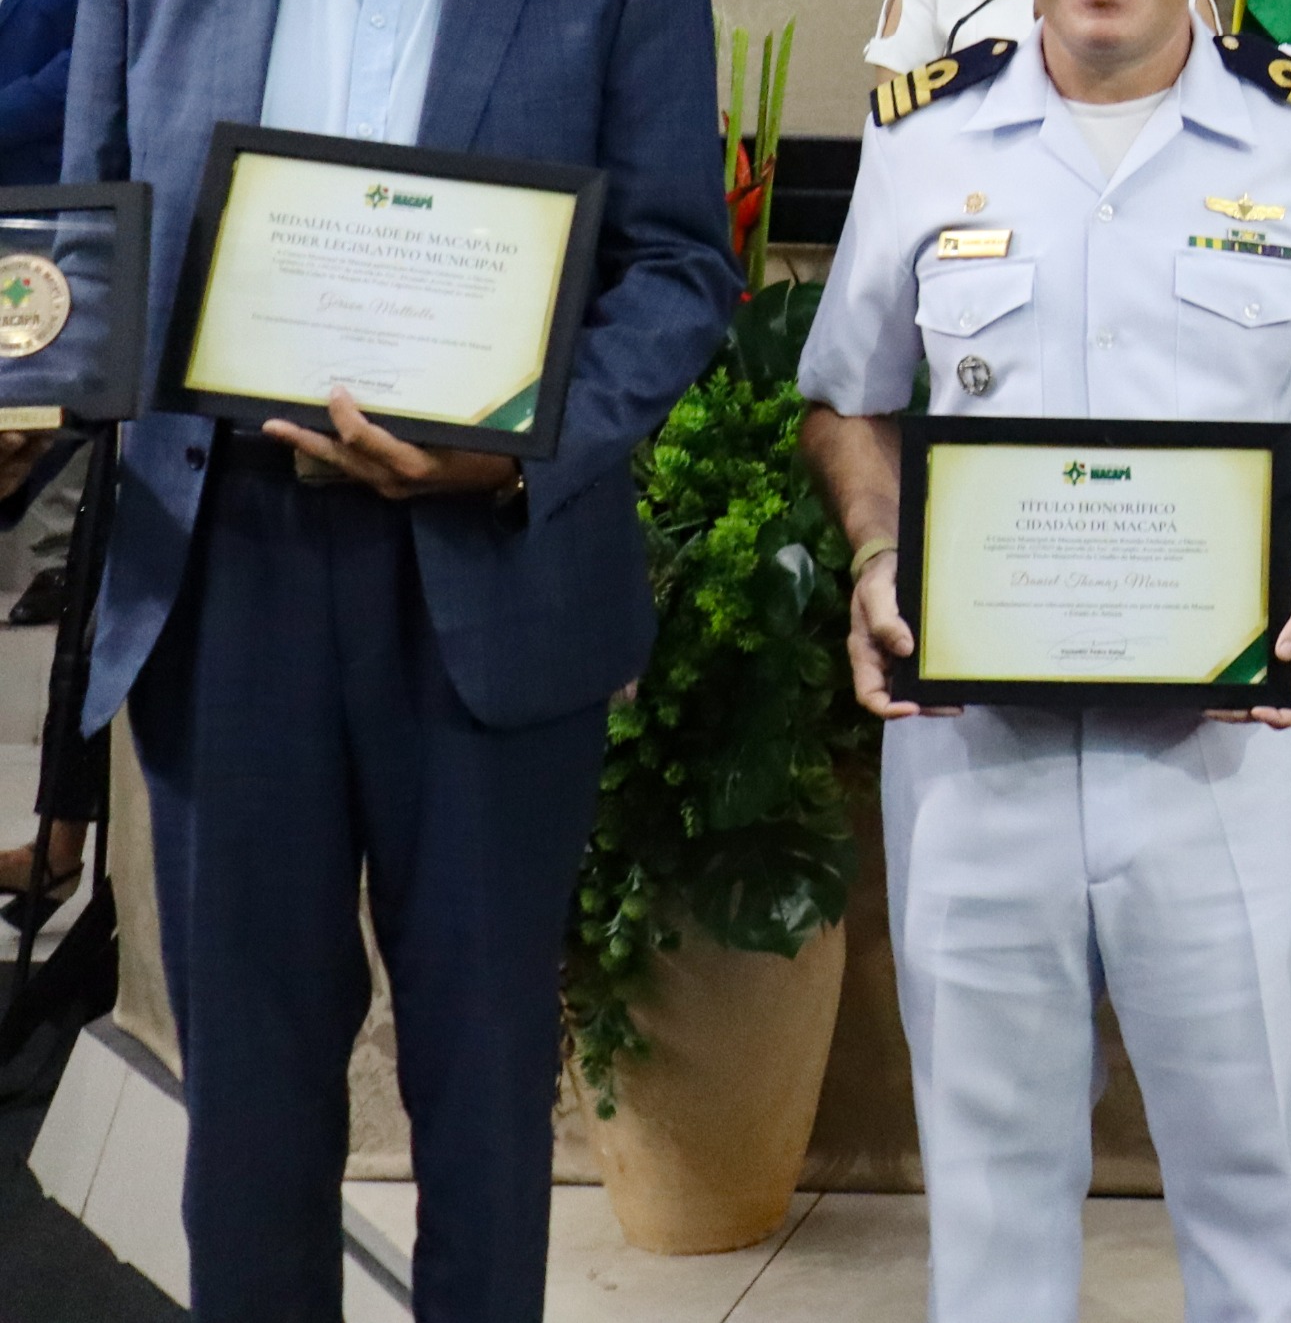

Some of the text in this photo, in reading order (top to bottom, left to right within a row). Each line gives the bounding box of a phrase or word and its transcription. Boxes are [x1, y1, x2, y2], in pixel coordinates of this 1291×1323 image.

[268, 211, 519, 256] MEDALHA CIDADE DE MACAPÁ DO
[270, 231, 508, 274] PODER LEGISLATIVO MUNICIPAL
[1018, 498, 1176, 516] TÍTULO HONORÍFICO
[1015, 517, 1177, 534] CIDADÃO DE MACAPÁ
